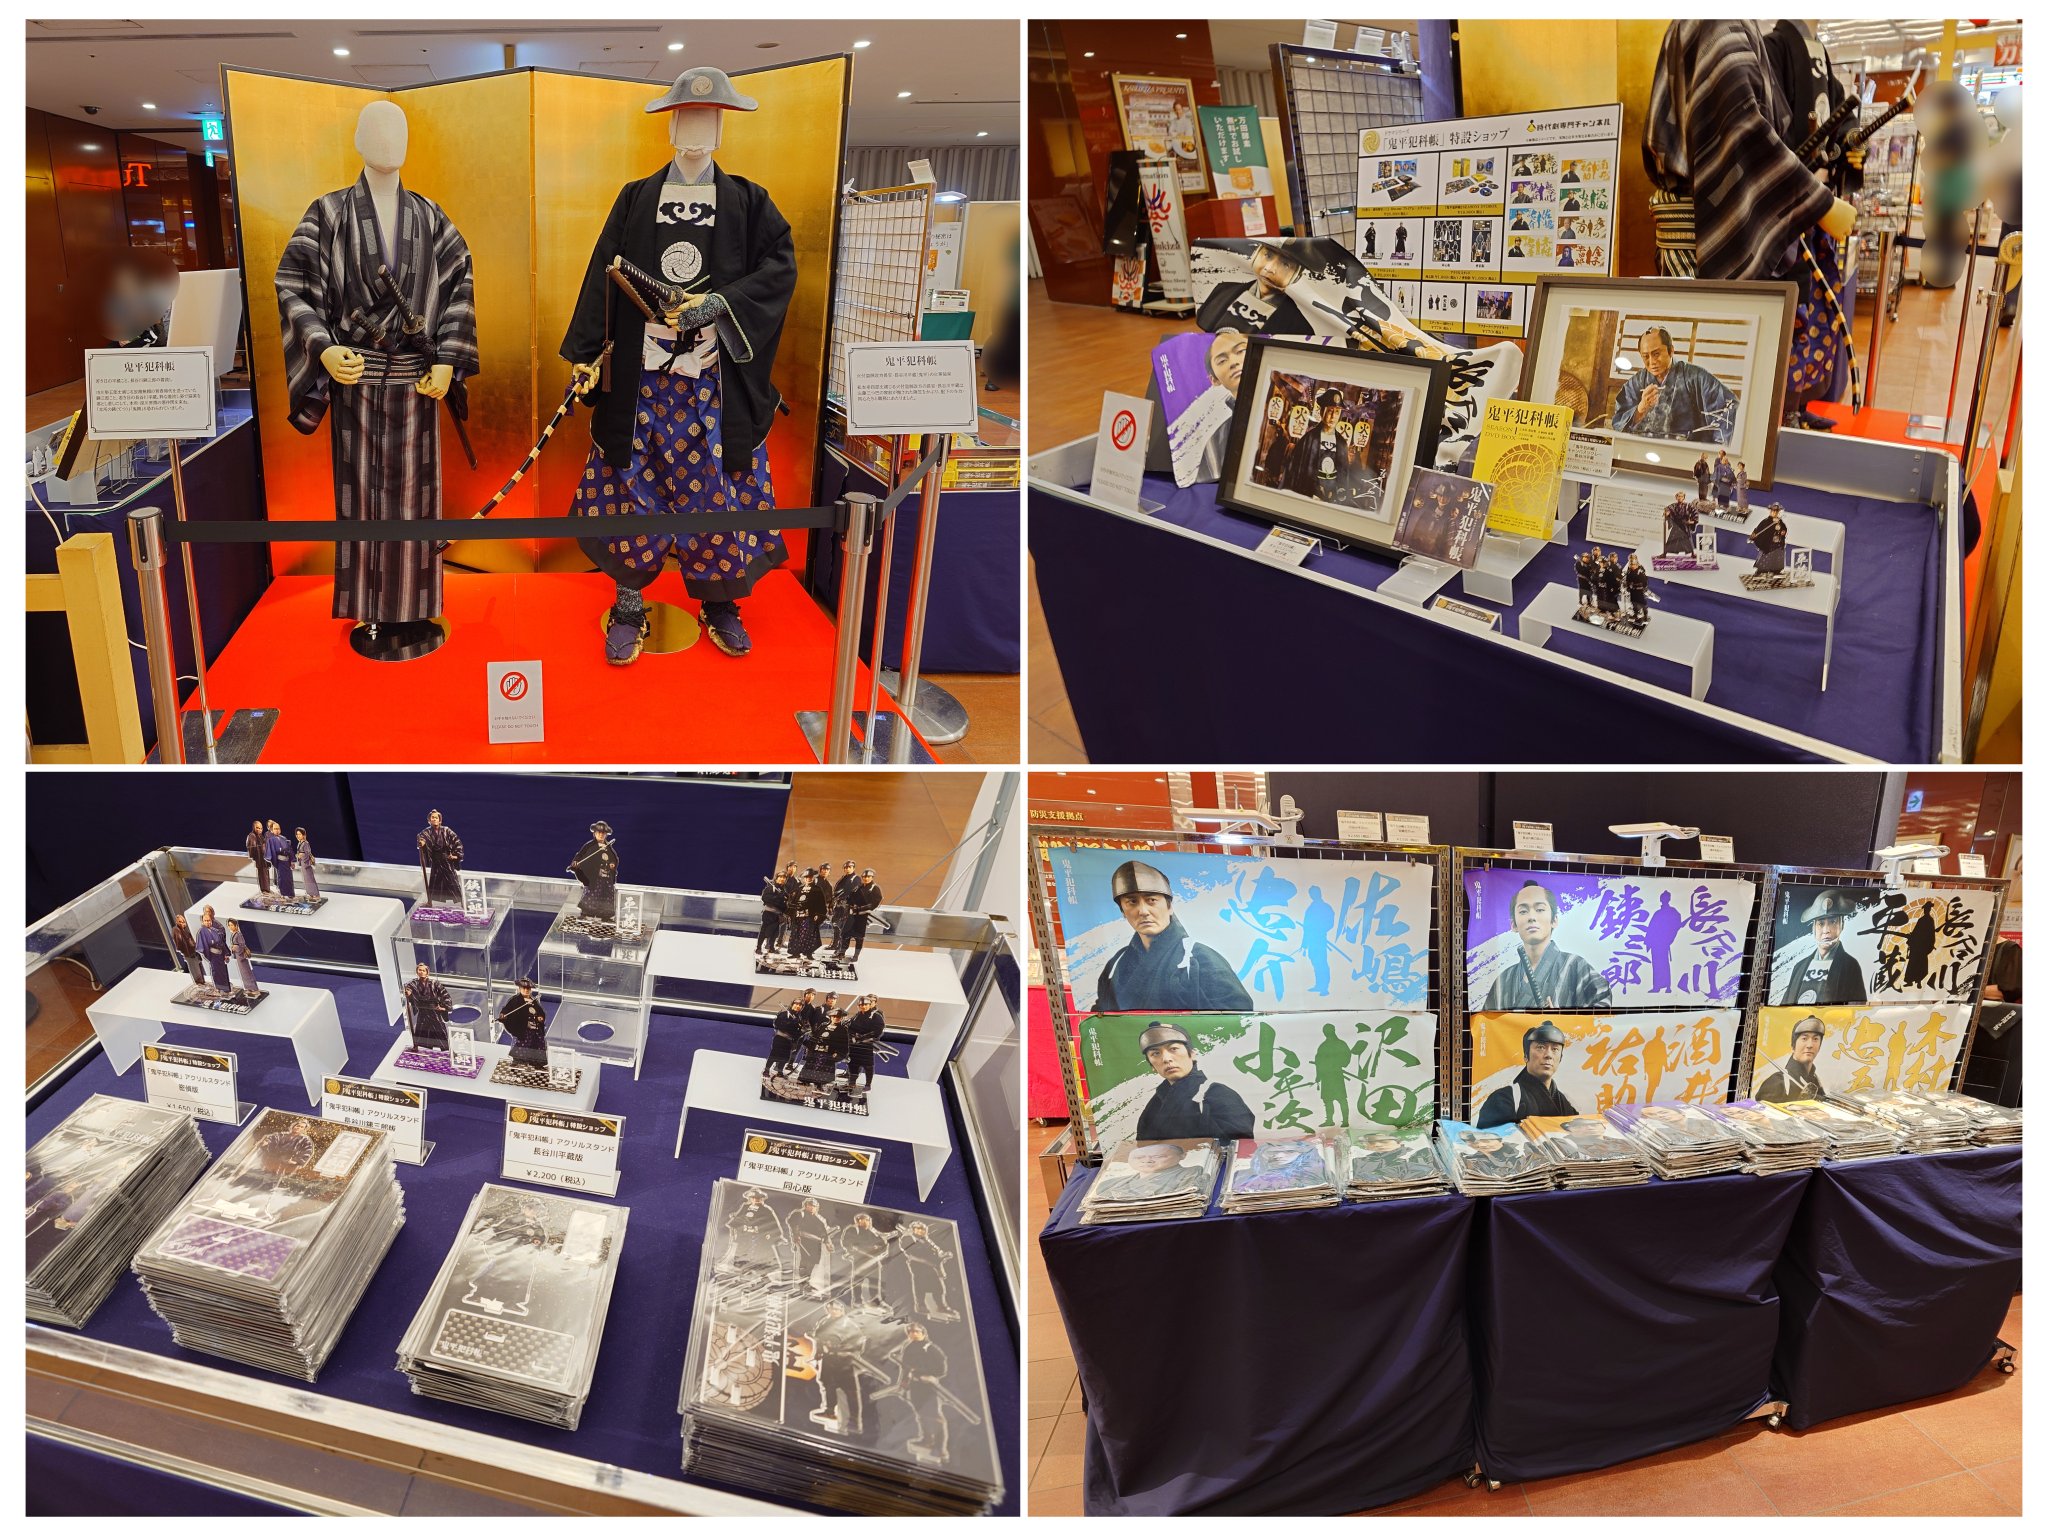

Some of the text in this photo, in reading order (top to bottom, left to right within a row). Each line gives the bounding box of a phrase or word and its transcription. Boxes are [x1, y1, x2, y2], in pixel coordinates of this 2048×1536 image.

[1536, 118, 1611, 132] 時代劇専門チャンネル
[124, 361, 175, 372] 鬼平犯科帳
[885, 355, 937, 367] 鬼平犯科帳
[1486, 424, 1513, 433] SEASON
[1488, 405, 1560, 429] 鬼平犯科帳
[1484, 431, 1500, 439] DVD
[1449, 486, 1483, 562] 鬼平犯科帳
[1030, 809, 1084, 821] 防災支援拠点
[1062, 859, 1078, 905] 鬼平犯科帳
[1677, 885, 1738, 999] 長谷川
[1927, 896, 1979, 995] 長谷川
[1088, 1027, 1104, 1067] 鬼平犯科帳
[1232, 1021, 1316, 1134] 小平次
[1350, 1015, 1422, 1128] 沢田
[508, 1131, 615, 1153] 「鬼平犯科帳」アクリルスタンド
[533, 1147, 584, 1162] 長谷川平蔵版
[743, 1161, 864, 1187] 「鬼平犯科帳」アクリルスタンド
[782, 1181, 813, 1194] 同心版
